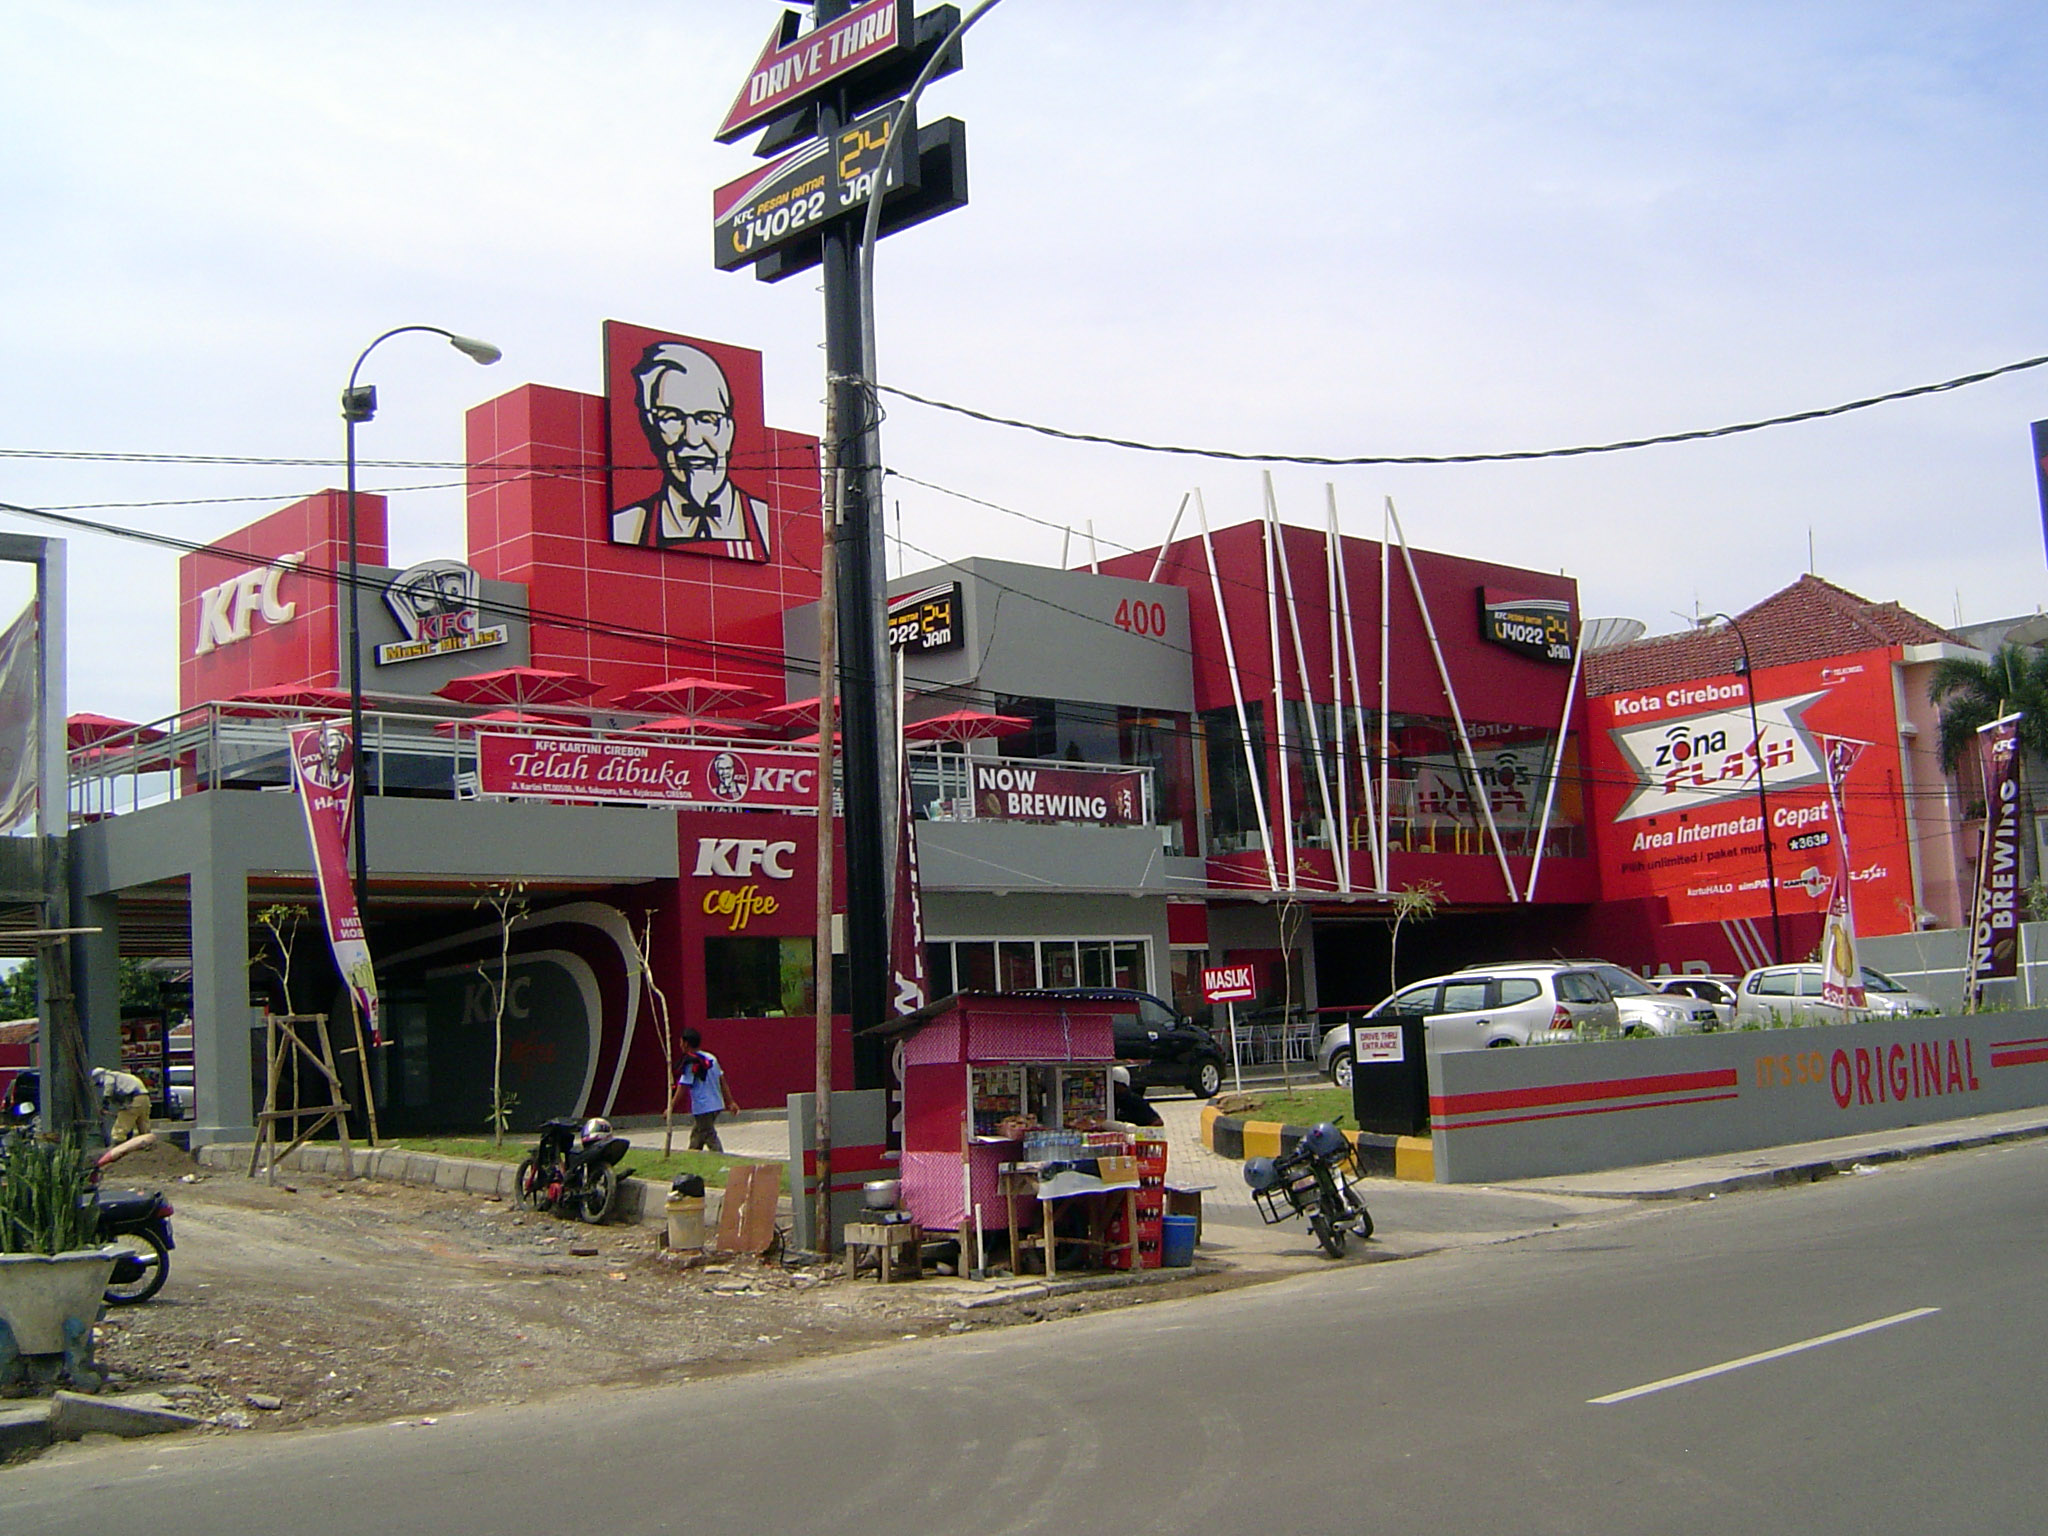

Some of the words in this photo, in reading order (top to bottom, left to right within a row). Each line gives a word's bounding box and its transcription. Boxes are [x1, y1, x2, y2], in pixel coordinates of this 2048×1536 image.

[750, 41, 824, 106] DRIVE
[829, 4, 894, 64] THRU
[840, 121, 889, 180] 24
[733, 208, 755, 227] KFC
[757, 191, 790, 216] PESAN
[791, 175, 825, 200] ANTAR
[745, 191, 826, 249] 14022
[195, 552, 305, 655] KFC
[922, 603, 950, 632] 24
[1114, 598, 1166, 637] 400
[416, 609, 475, 641] KFC
[888, 622, 919, 645] 022
[923, 629, 951, 648] JAM
[1502, 622, 1543, 645] 14022
[1546, 615, 1569, 643] 24
[386, 642, 435, 660] Music
[440, 637, 464, 651] Hit
[469, 629, 501, 647] List
[1547, 644, 1571, 660] JAM
[1614, 695, 1661, 716] Kota
[1665, 683, 1744, 707] Cirebon
[534, 740, 558, 752] KFC
[558, 742, 602, 755] KARTINI
[603, 745, 649, 758] CIREBON
[1655, 730, 1727, 768] zona
[1663, 724, 1795, 796] FLASH
[1993, 738, 2017, 754] KFC
[509, 752, 590, 780] Telah
[597, 757, 691, 790] dibuka
[750, 767, 813, 793] KFC
[978, 769, 1037, 793] NOW
[1007, 793, 1107, 820] BREWING
[1122, 788, 1132, 820] KFC
[1632, 831, 1673, 851] Area
[1773, 800, 1829, 829] Cepat
[692, 838, 796, 879] KFC
[1647, 853, 1698, 871] unlimited
[1706, 846, 1738, 863] paket
[1740, 840, 1777, 855] murh
[1205, 968, 1250, 990] MASUK
[1360, 1032, 1379, 1041] DRIVE
[1381, 1031, 1398, 1040] THRU
[1362, 1041, 1397, 1050] ENTRANCE
[1796, 1050, 1825, 1084] SO
[1830, 1038, 1979, 1109] ORIGINAL
